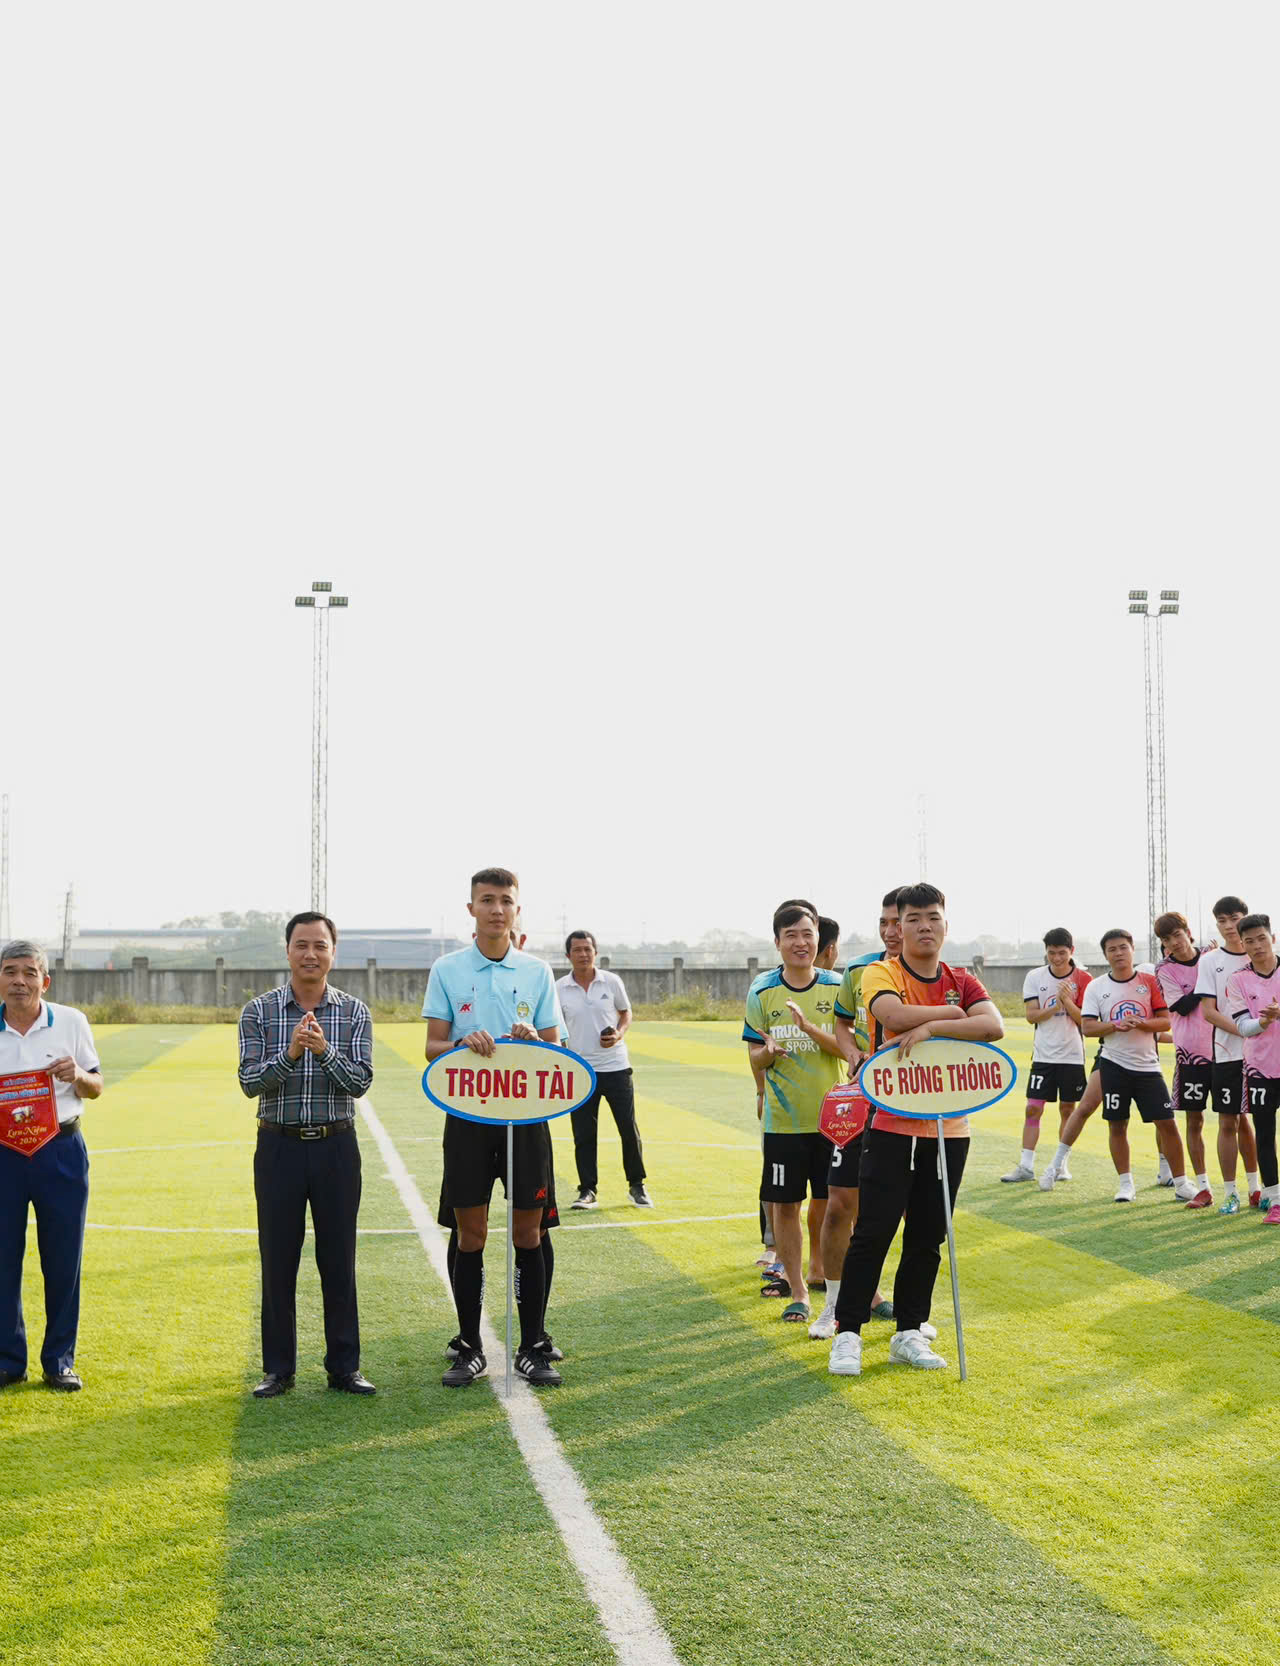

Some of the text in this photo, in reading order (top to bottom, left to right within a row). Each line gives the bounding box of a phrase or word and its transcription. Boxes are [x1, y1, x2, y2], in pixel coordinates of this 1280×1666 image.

[445, 1064, 574, 1105] TRỌNG TÀI
[873, 1057, 1003, 1096] FC RỪNG THÔNG
[1030, 1074, 1044, 1090] 17
[1184, 1082, 1203, 1100] 25
[1222, 1088, 1231, 1104] 3
[1249, 1087, 1266, 1105] 77
[772, 1162, 785, 1187] 11
